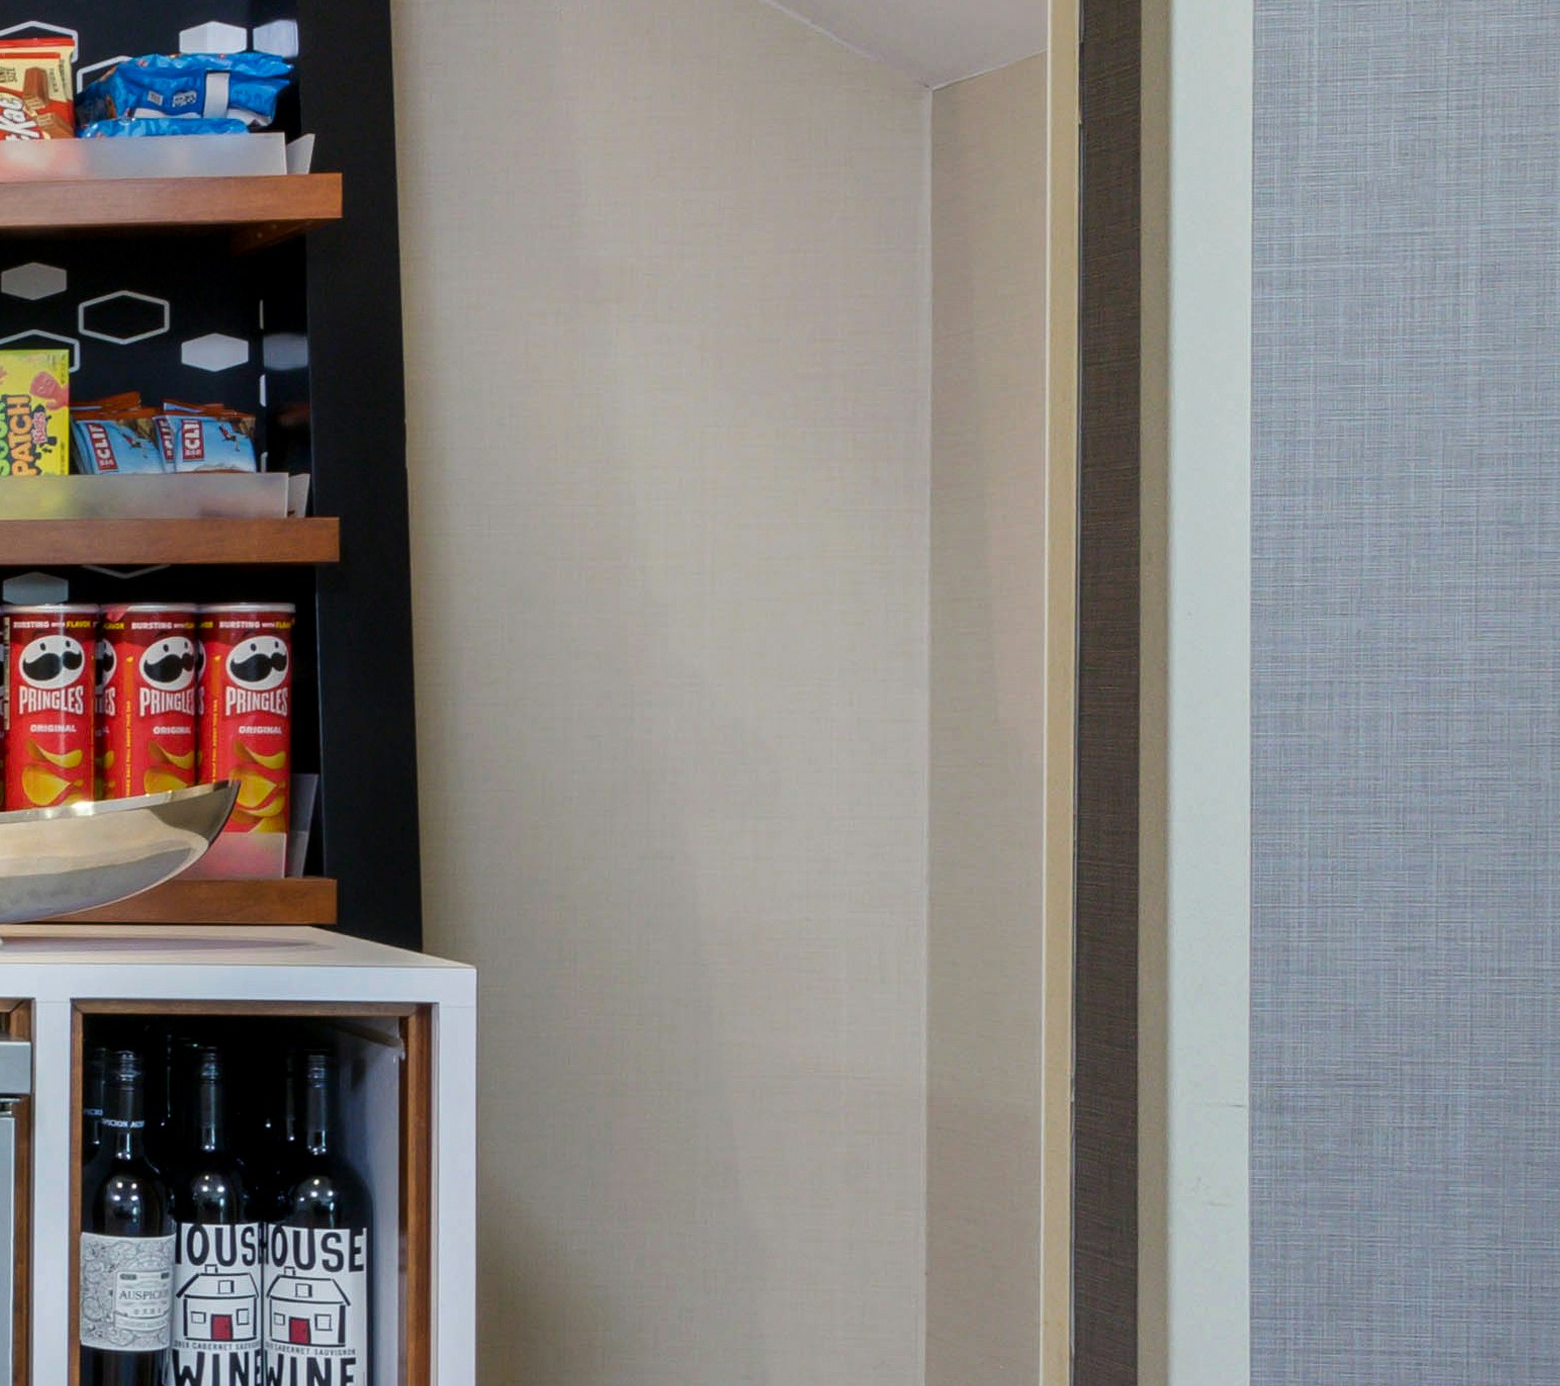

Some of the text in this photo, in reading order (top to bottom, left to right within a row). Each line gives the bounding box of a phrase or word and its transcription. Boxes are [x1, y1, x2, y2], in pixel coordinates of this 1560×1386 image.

[7, 393, 34, 477] PATCH
[19, 685, 84, 715] PRINGLES
[225, 686, 288, 717] PRINGLES
[30, 724, 77, 733] ORIGINAL
[239, 725, 282, 734] ORIGINAL
